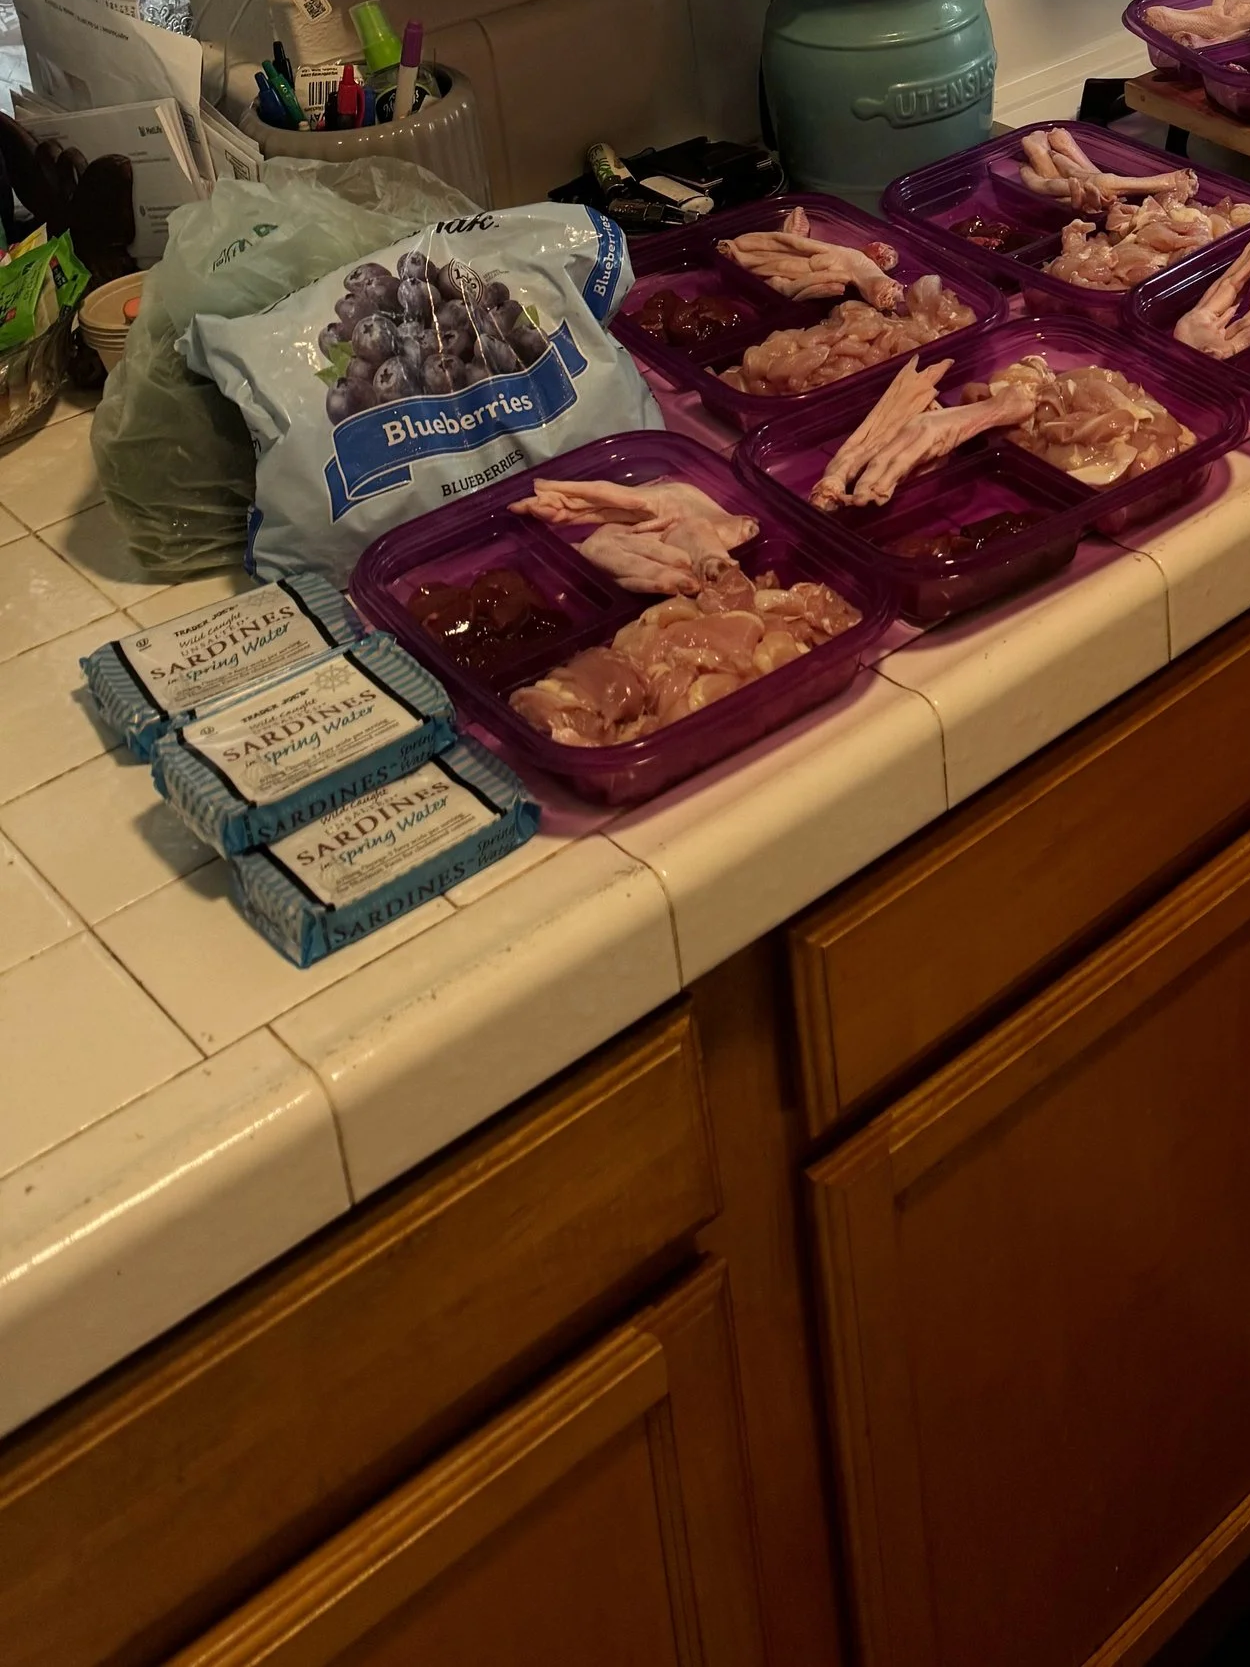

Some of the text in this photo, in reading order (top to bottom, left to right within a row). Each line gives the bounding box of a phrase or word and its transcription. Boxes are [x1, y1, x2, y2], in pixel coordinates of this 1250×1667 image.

[896, 60, 994, 120] UTENSILS
[593, 215, 616, 297] Blueberries
[382, 393, 534, 447] Blueberries
[441, 449, 525, 498] BLUEBERRIES
[151, 606, 296, 681] SARDINES
[242, 622, 291, 657] Water
[223, 689, 377, 763] SARDINES
[322, 704, 375, 736] Water
[296, 781, 450, 867] SARDINES
[399, 794, 451, 833] Water
